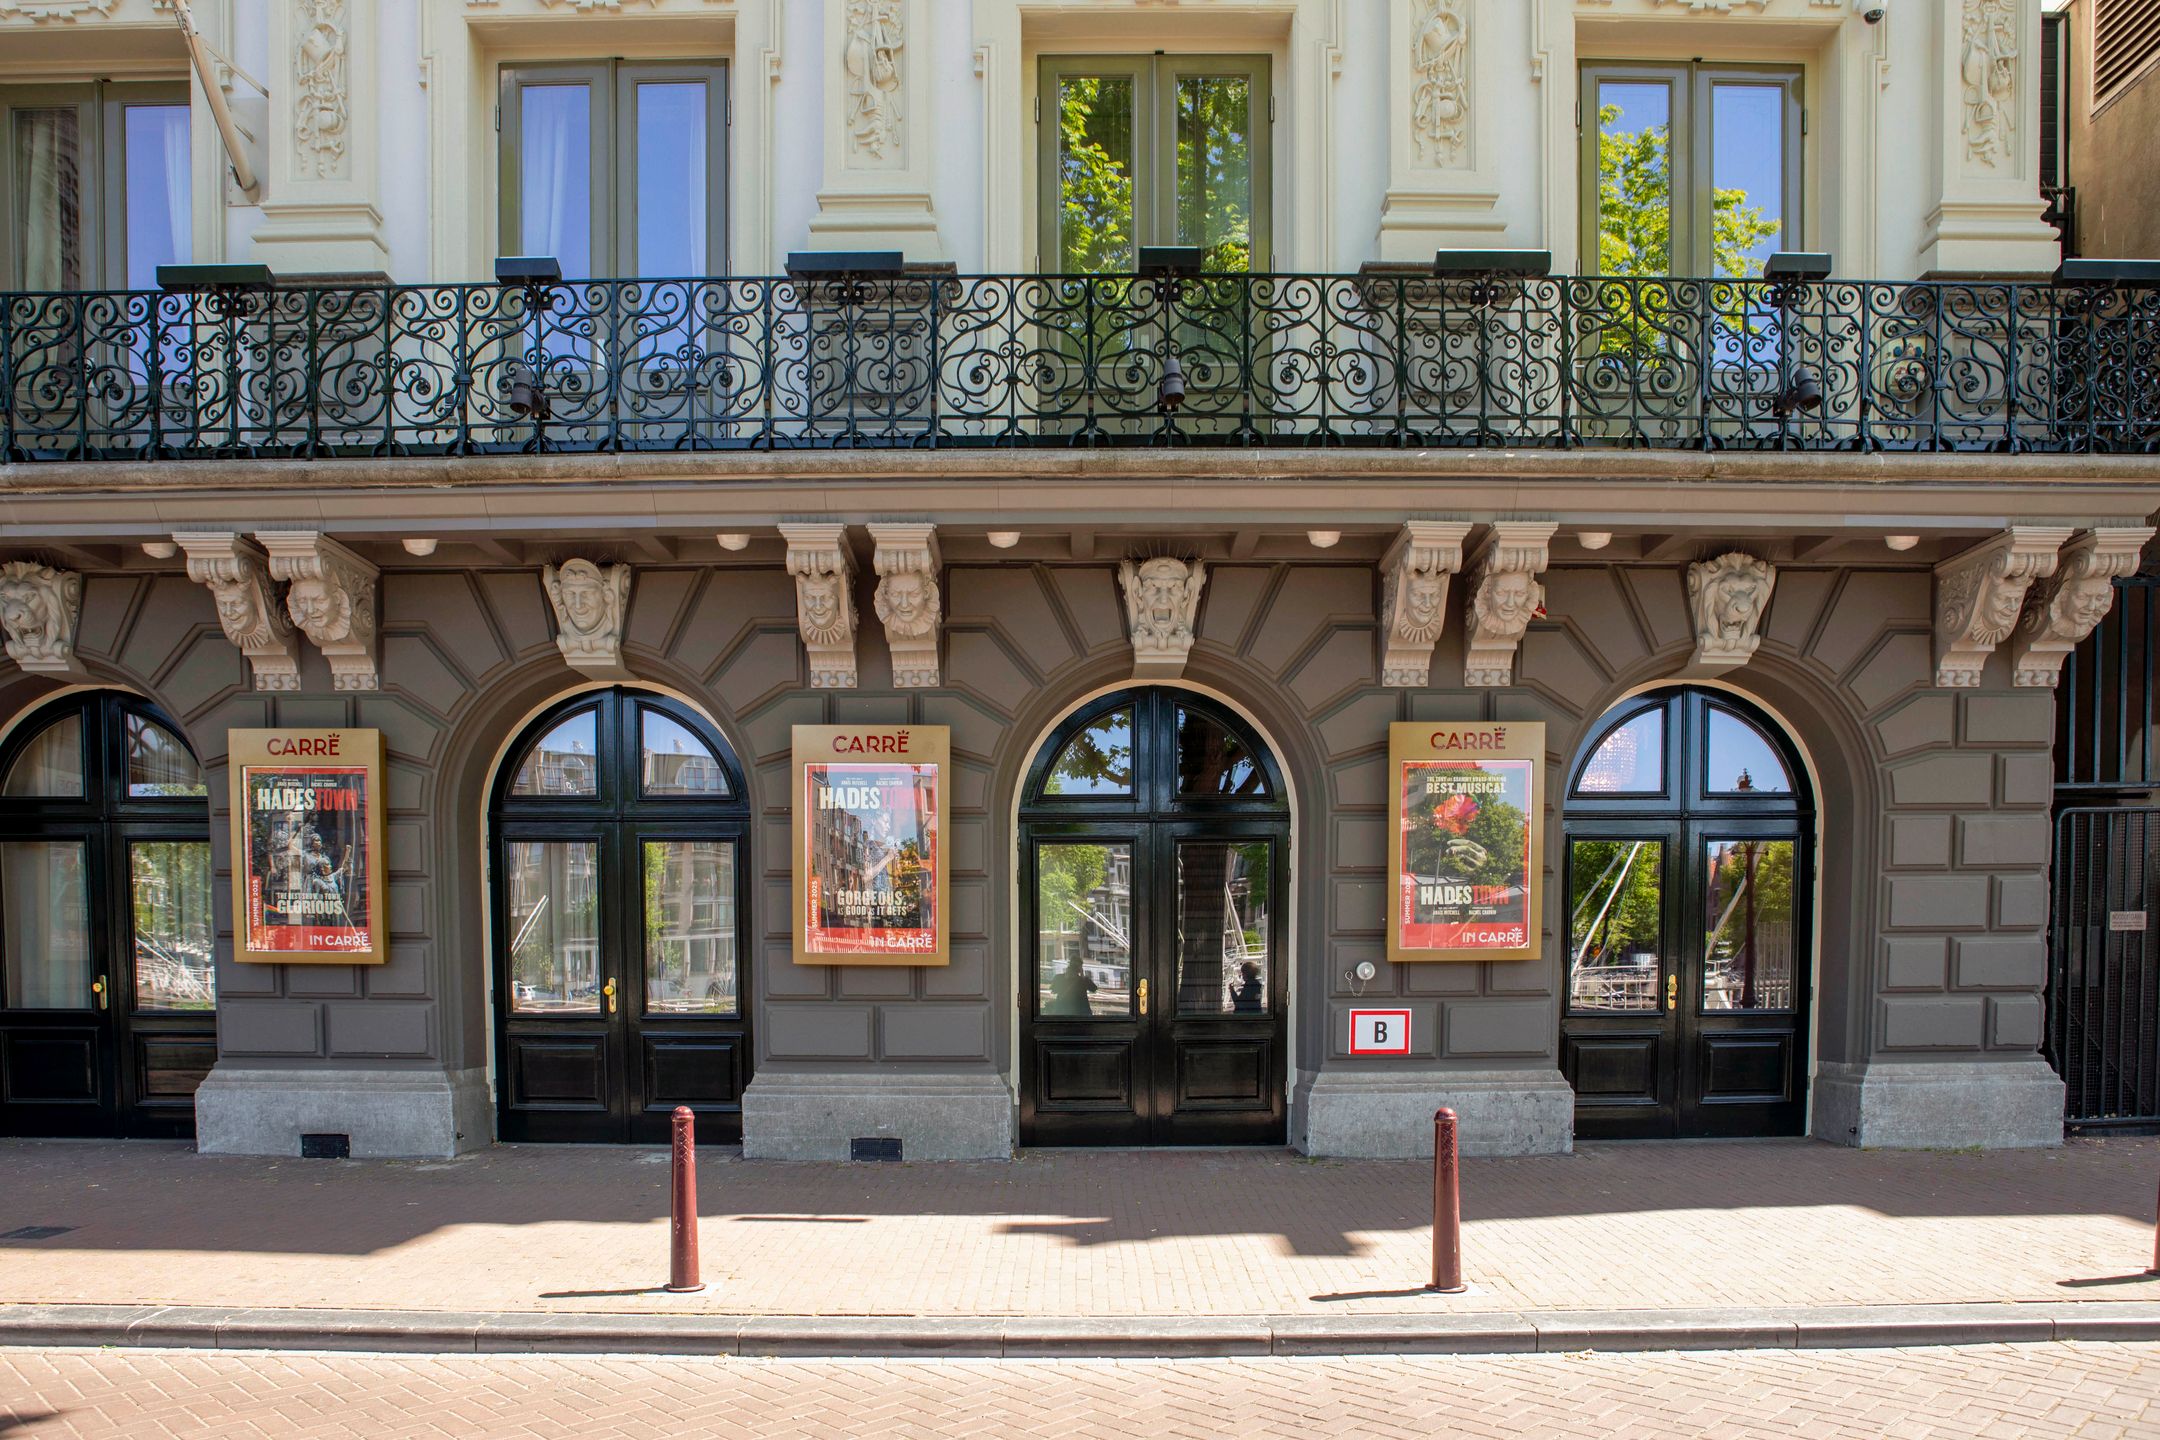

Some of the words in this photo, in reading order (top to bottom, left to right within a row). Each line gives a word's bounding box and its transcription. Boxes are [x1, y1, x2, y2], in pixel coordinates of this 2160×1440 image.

[1426, 782, 1455, 794] BEST
[1456, 782, 1507, 794] MUSICAL
[257, 788, 359, 811] HADESTOWN
[1420, 885, 1510, 906] HADESTOWN
[845, 905, 867, 915] GOOD
[877, 906, 885, 915] IT
[309, 935, 323, 946] IN
[870, 936, 884, 948] IN
[1462, 932, 1476, 943] IN
[1374, 1021, 1388, 1043] B
